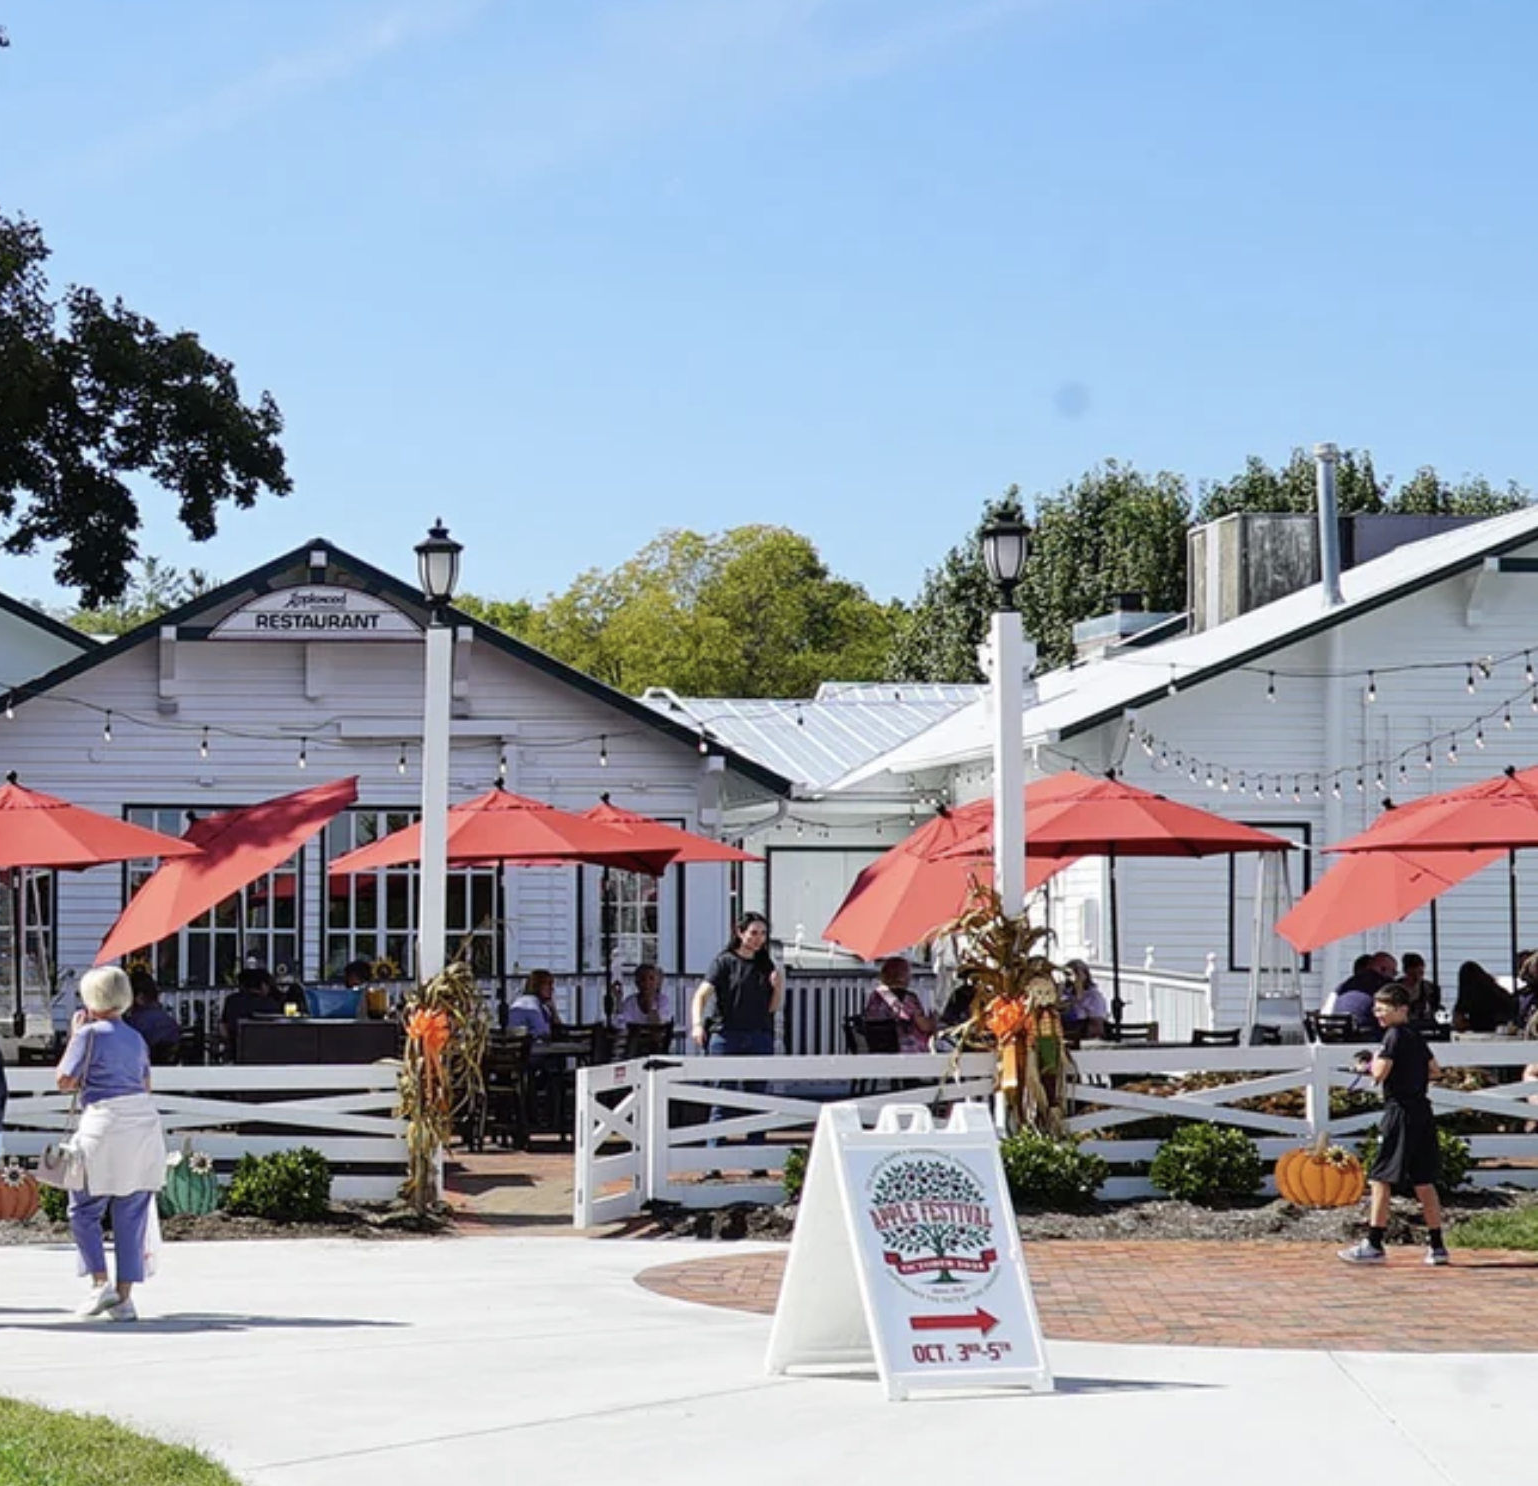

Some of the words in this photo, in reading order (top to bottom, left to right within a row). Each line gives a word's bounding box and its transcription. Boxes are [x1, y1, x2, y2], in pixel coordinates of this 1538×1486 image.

[255, 614, 379, 629] RESTAURANT
[869, 1203, 918, 1229] APPLE
[918, 1202, 993, 1228] FESTIVAL
[912, 1343, 953, 1362] OCT.
